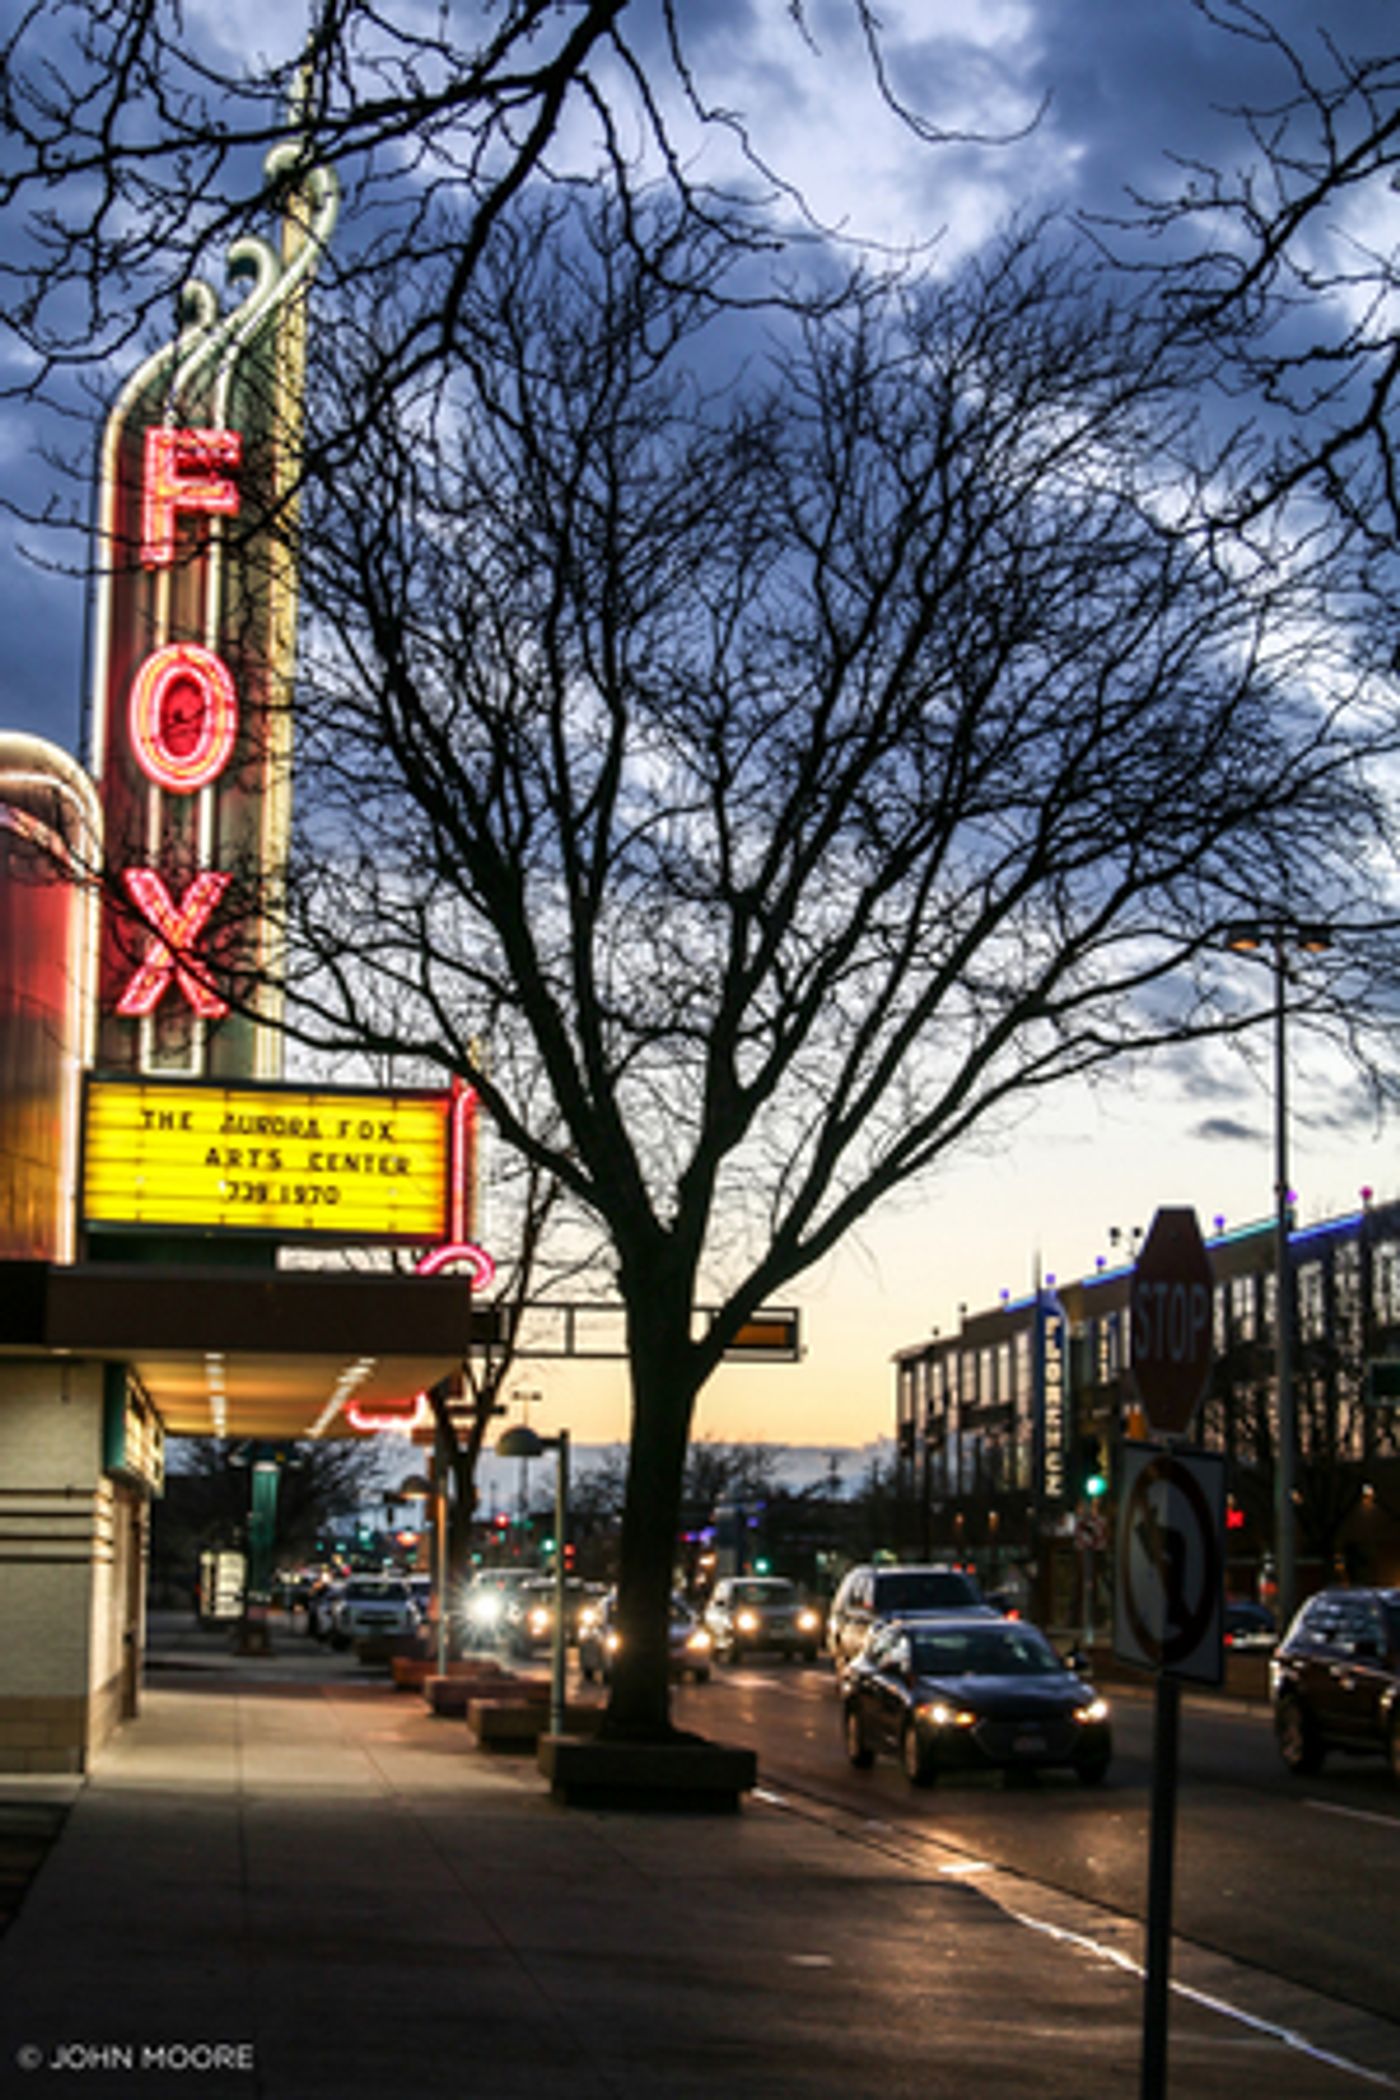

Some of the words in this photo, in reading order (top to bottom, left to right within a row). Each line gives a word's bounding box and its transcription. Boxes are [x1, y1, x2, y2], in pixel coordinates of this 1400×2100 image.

[115, 426, 242, 1018] FOX
[140, 1110, 193, 1131] THE
[220, 1112, 323, 1140] AURORA
[337, 1119, 397, 1142] FOX
[205, 1147, 283, 1170] ARTS
[308, 1152, 411, 1176] CENTER
[1134, 1282, 1209, 1363] STOP
